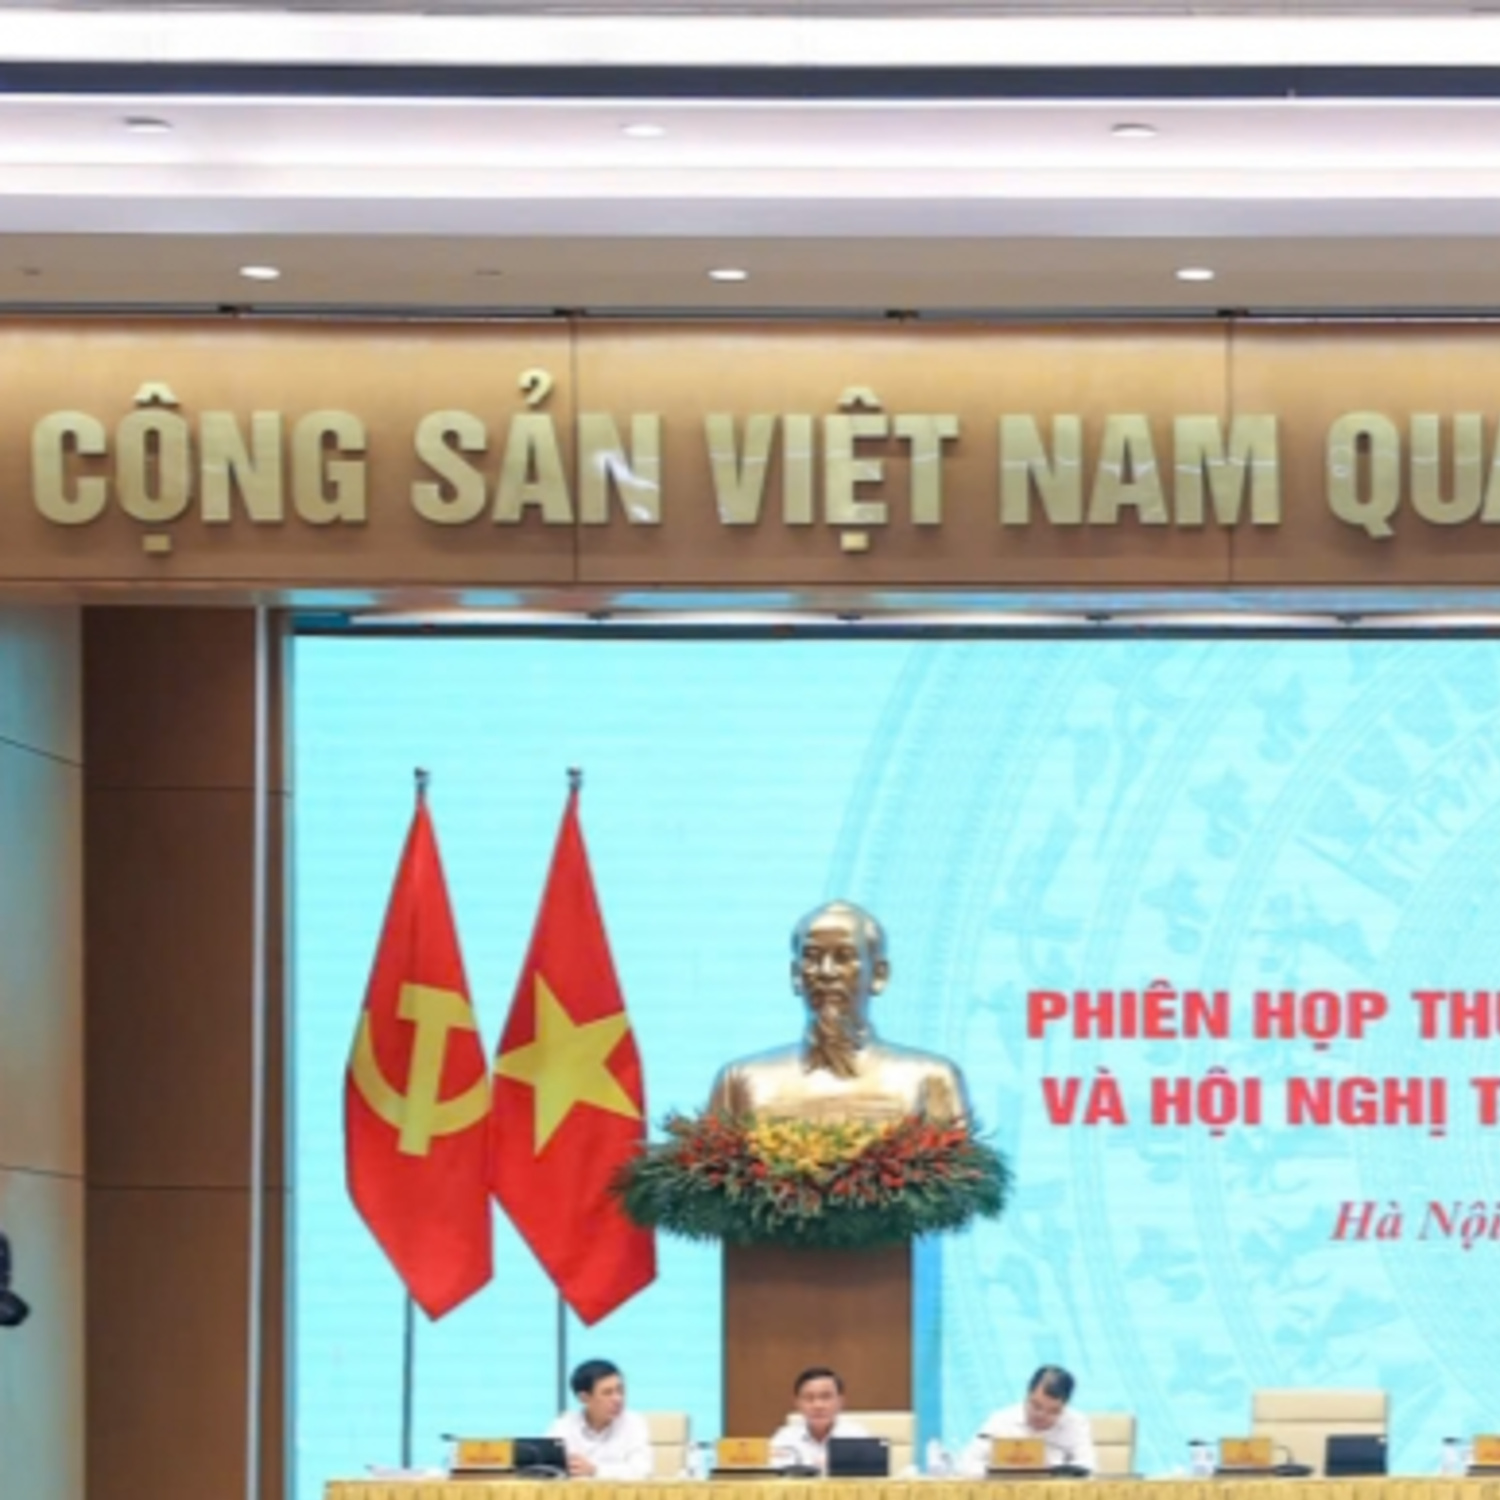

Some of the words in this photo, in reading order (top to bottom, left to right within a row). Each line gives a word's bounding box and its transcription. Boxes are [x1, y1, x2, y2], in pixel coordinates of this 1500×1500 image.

[31, 381, 367, 552] CỘNG
[411, 369, 662, 526] SẢN
[704, 386, 959, 552] VIỆT
[1000, 412, 1280, 526] NAM
[1026, 978, 1231, 1040] PHIÊN
[1252, 990, 1390, 1051] HỌP
[1041, 1066, 1129, 1126] VÀ
[1150, 1066, 1261, 1137] HỘI
[1286, 1077, 1447, 1137] NGHỊ
[1330, 1201, 1403, 1241] Hà
